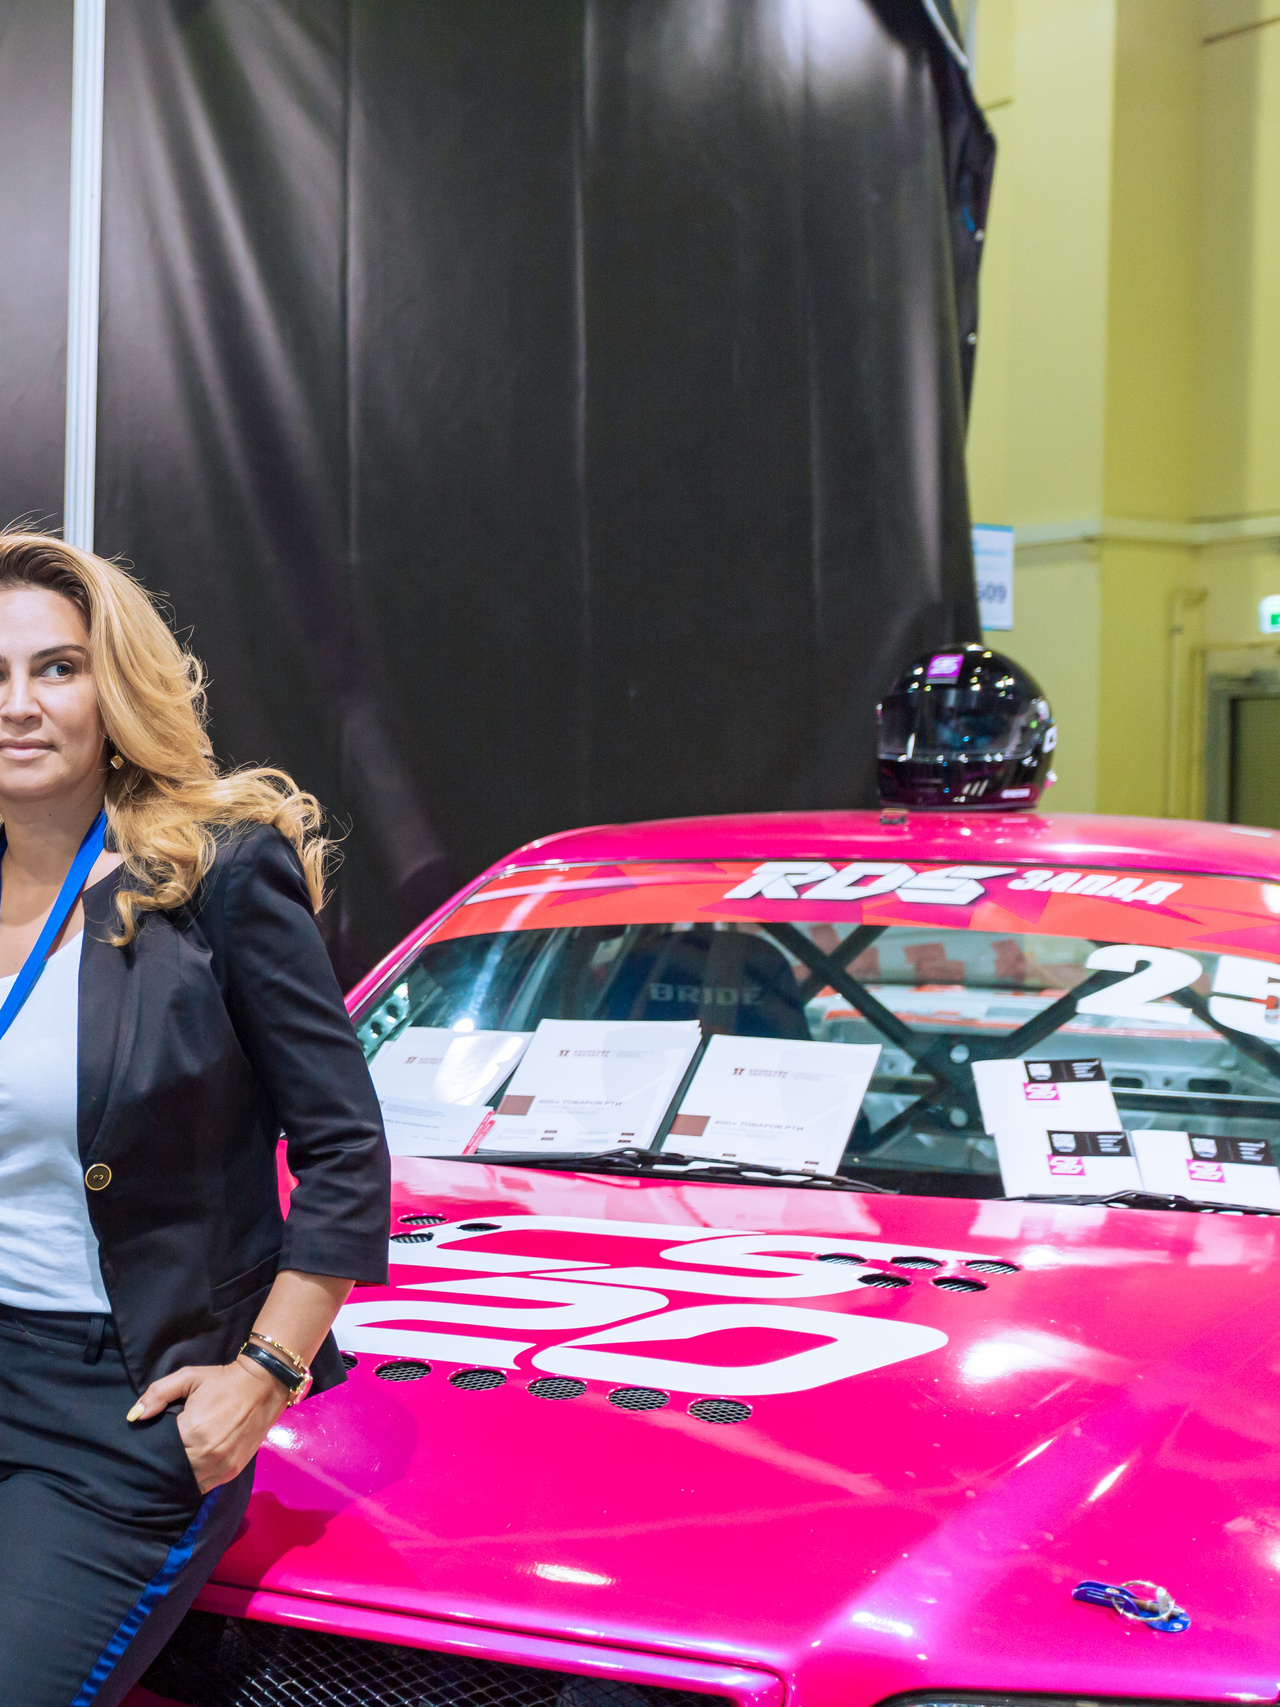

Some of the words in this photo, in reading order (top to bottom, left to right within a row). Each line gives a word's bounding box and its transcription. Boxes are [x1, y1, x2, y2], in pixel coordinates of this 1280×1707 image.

[723, 861, 1018, 906] RDS
[1008, 869, 1185, 906] ЗАПАД
[649, 983, 762, 1006] BRIDE
[1075, 944, 1280, 1042] 25
[331, 1276, 950, 1397] 20
